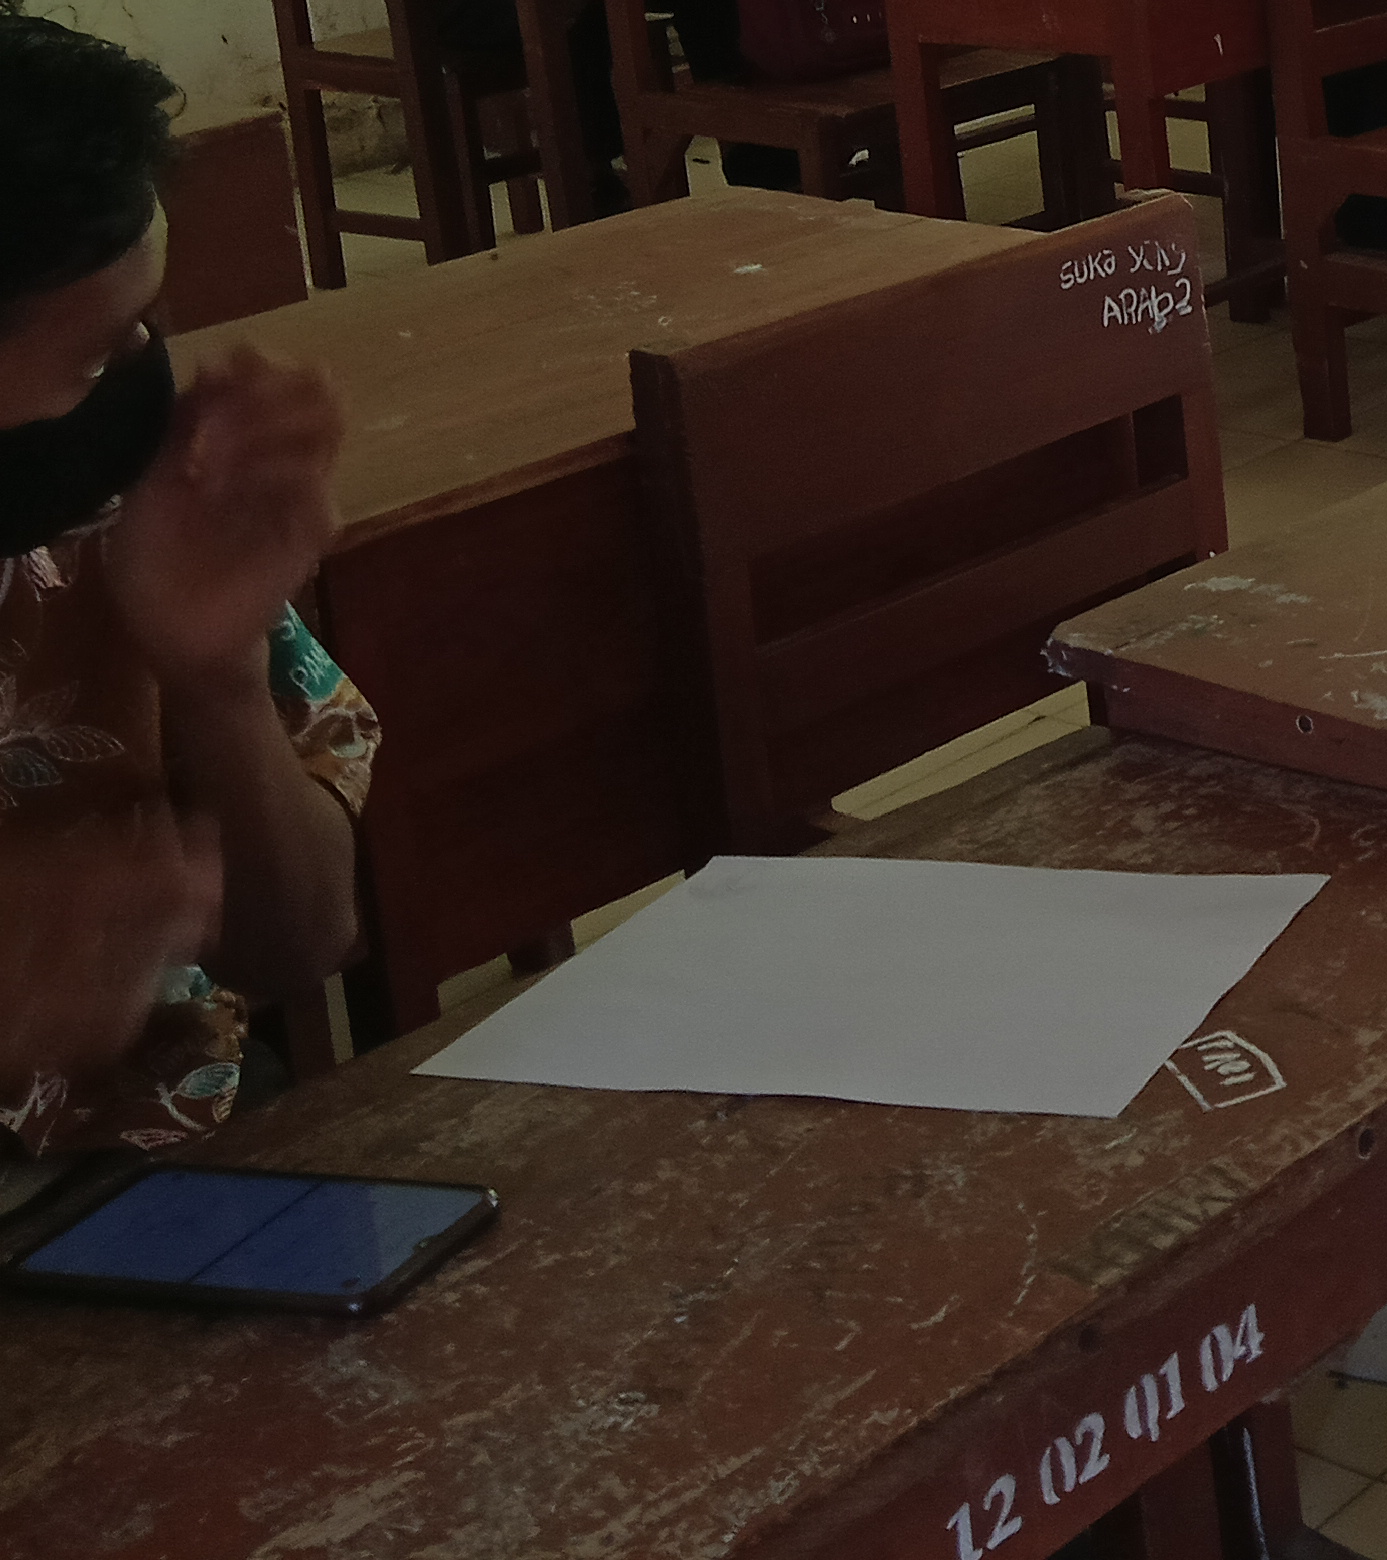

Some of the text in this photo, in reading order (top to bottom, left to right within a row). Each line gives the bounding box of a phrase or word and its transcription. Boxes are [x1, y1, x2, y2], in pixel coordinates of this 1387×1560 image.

[946, 1304, 1265, 1560] 12 02 01 04
